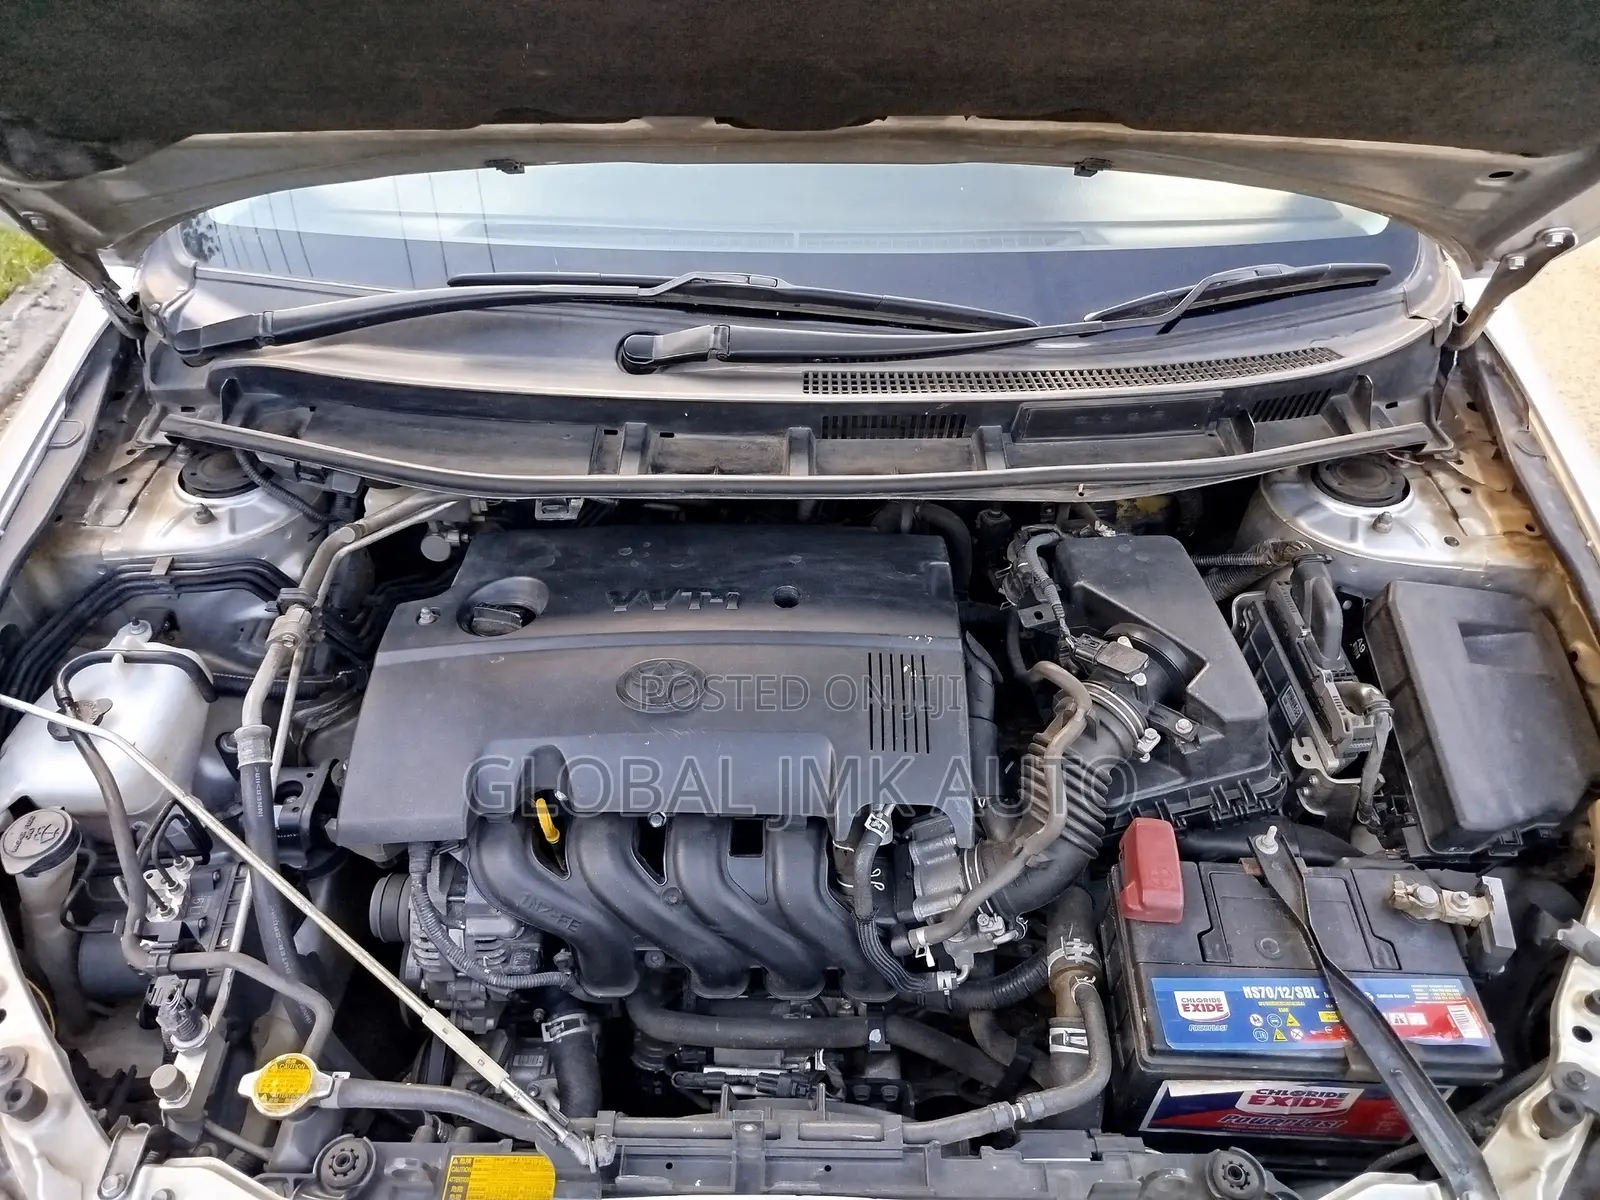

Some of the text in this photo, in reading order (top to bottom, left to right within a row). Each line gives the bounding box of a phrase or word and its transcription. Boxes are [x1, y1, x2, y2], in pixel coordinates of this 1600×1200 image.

[1182, 1004, 1224, 1012] EXIDE
[1255, 1088, 1350, 1099] CHLORIDE
[1246, 1095, 1346, 1109] EXIDE
